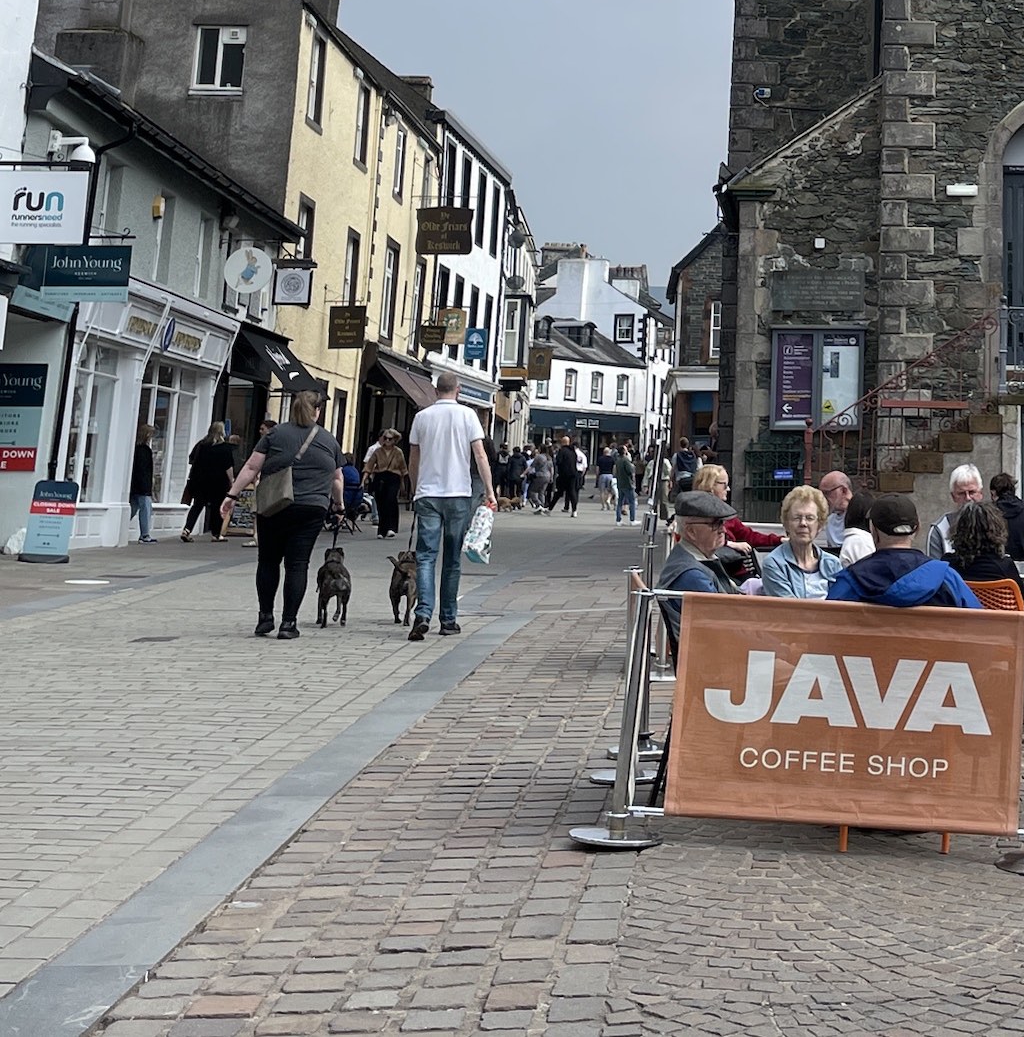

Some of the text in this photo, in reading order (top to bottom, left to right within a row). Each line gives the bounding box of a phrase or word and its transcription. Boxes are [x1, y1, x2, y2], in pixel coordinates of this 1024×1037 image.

[13, 190, 64, 211] run
[11, 213, 63, 221] runnersneed
[51, 255, 122, 271] John Young
[3, 374, 43, 389] Young
[2, 450, 34, 459] DOWN
[704, 650, 992, 736] JAVA
[738, 747, 949, 779] COFFEE SHOP
